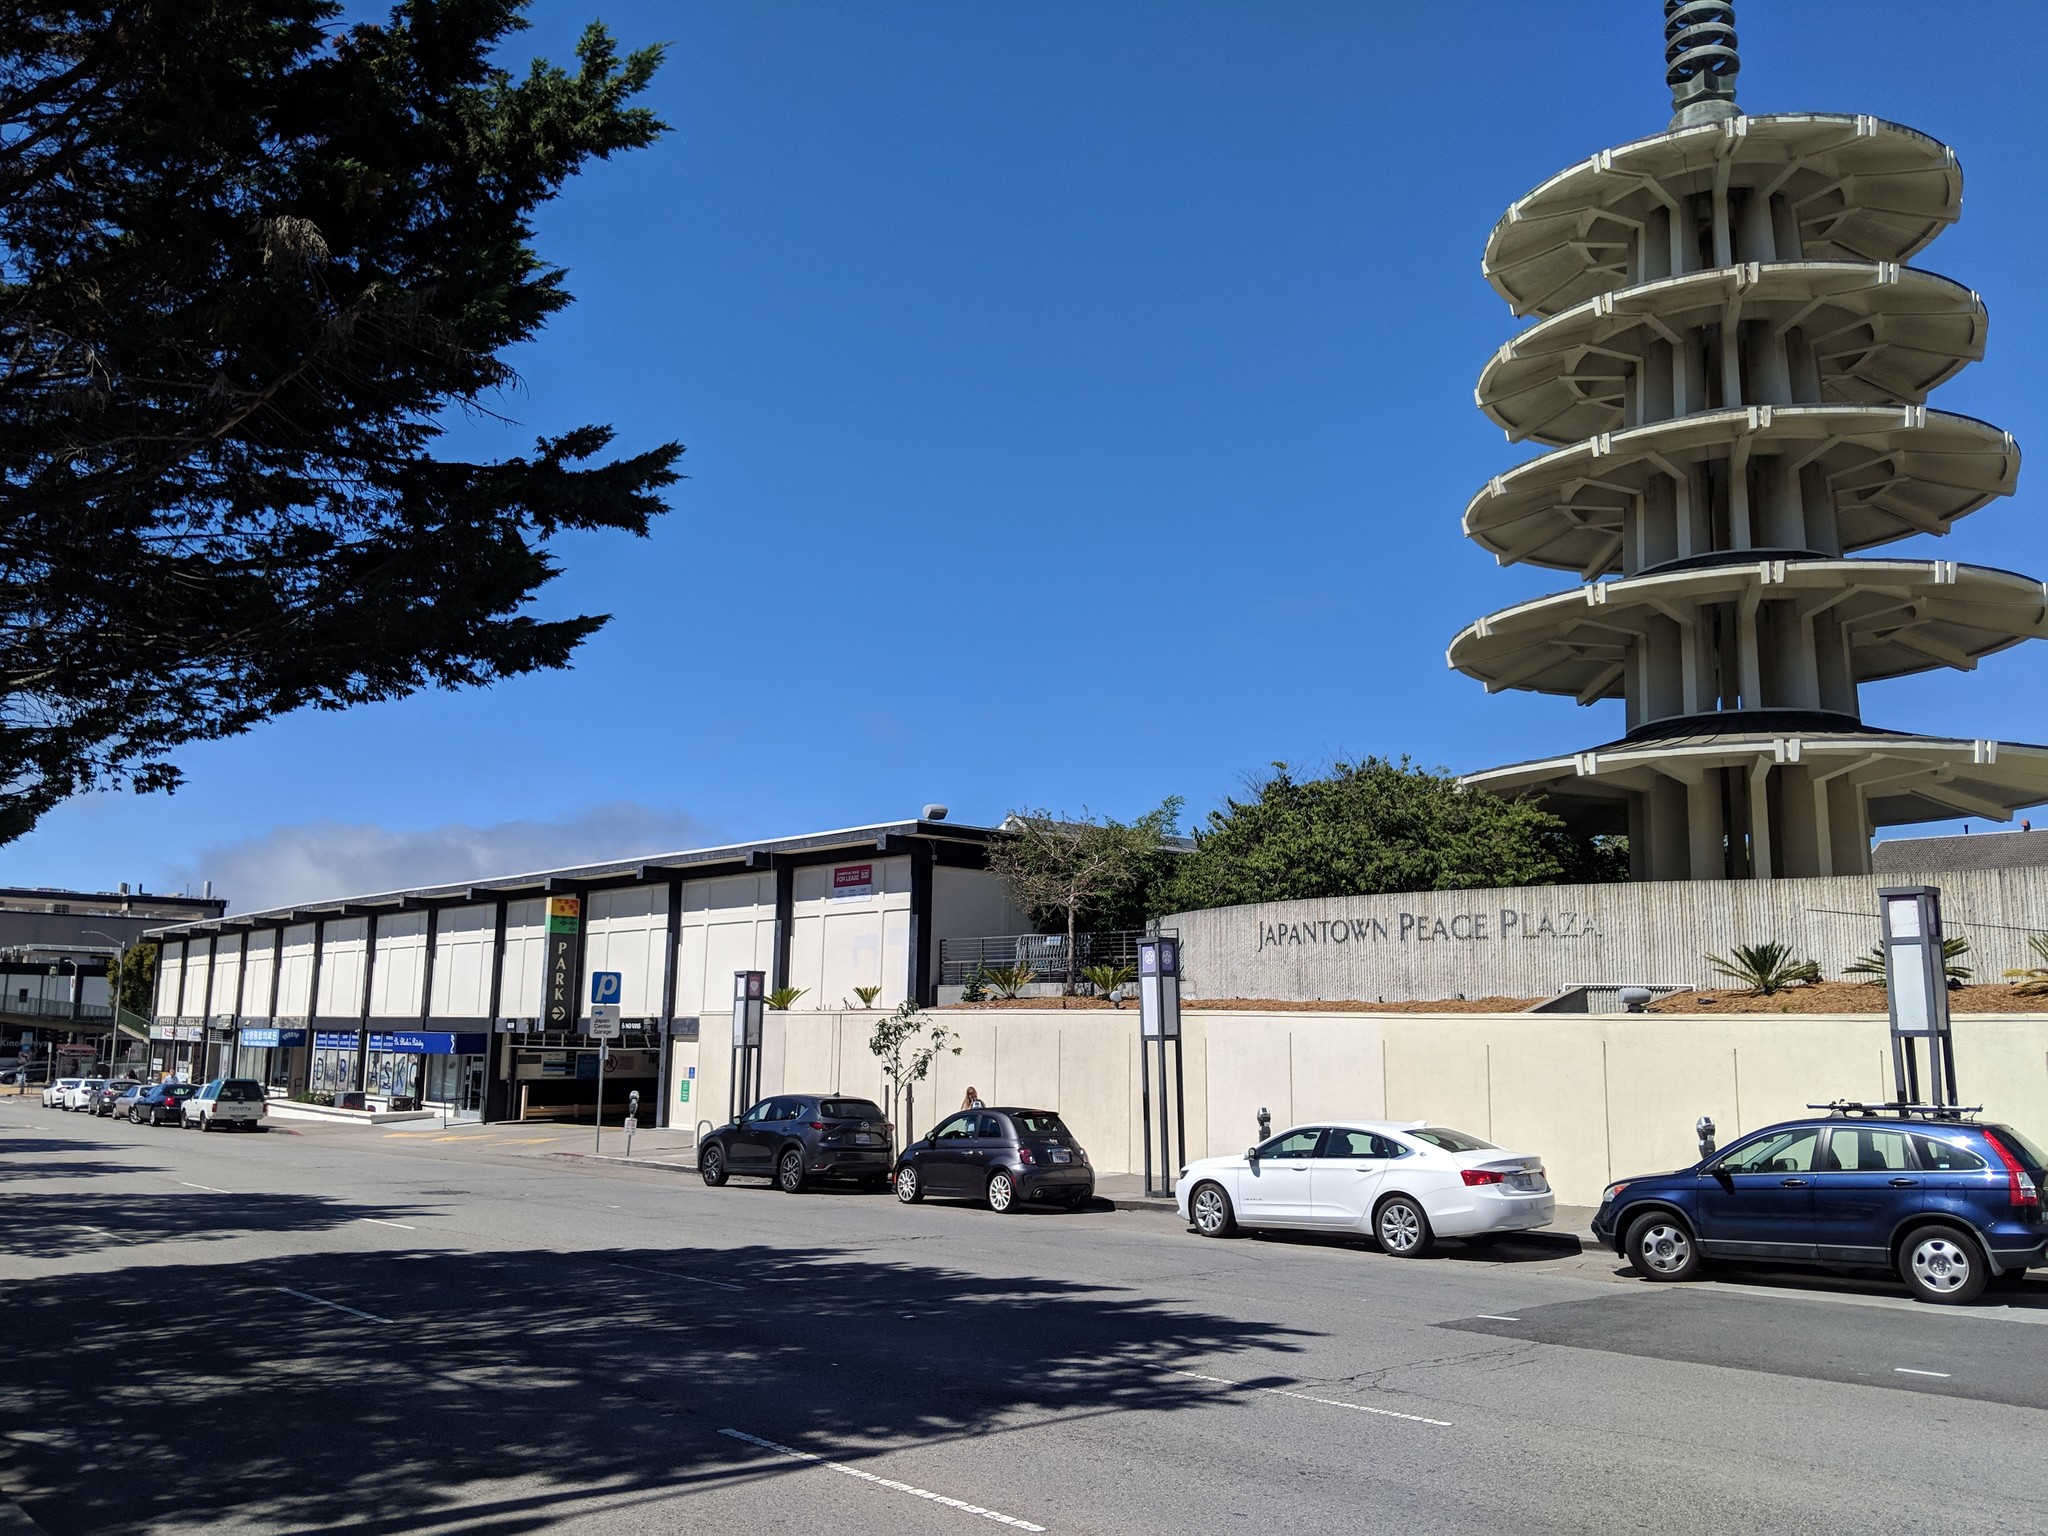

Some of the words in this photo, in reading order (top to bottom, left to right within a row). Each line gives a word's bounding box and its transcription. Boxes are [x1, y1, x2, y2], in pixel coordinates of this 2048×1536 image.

[1258, 917, 1389, 952] JAPANTOWN
[1400, 912, 1490, 942] PEACE
[1500, 909, 1604, 939] PLAZA
[554, 942, 568, 1001] PARK
